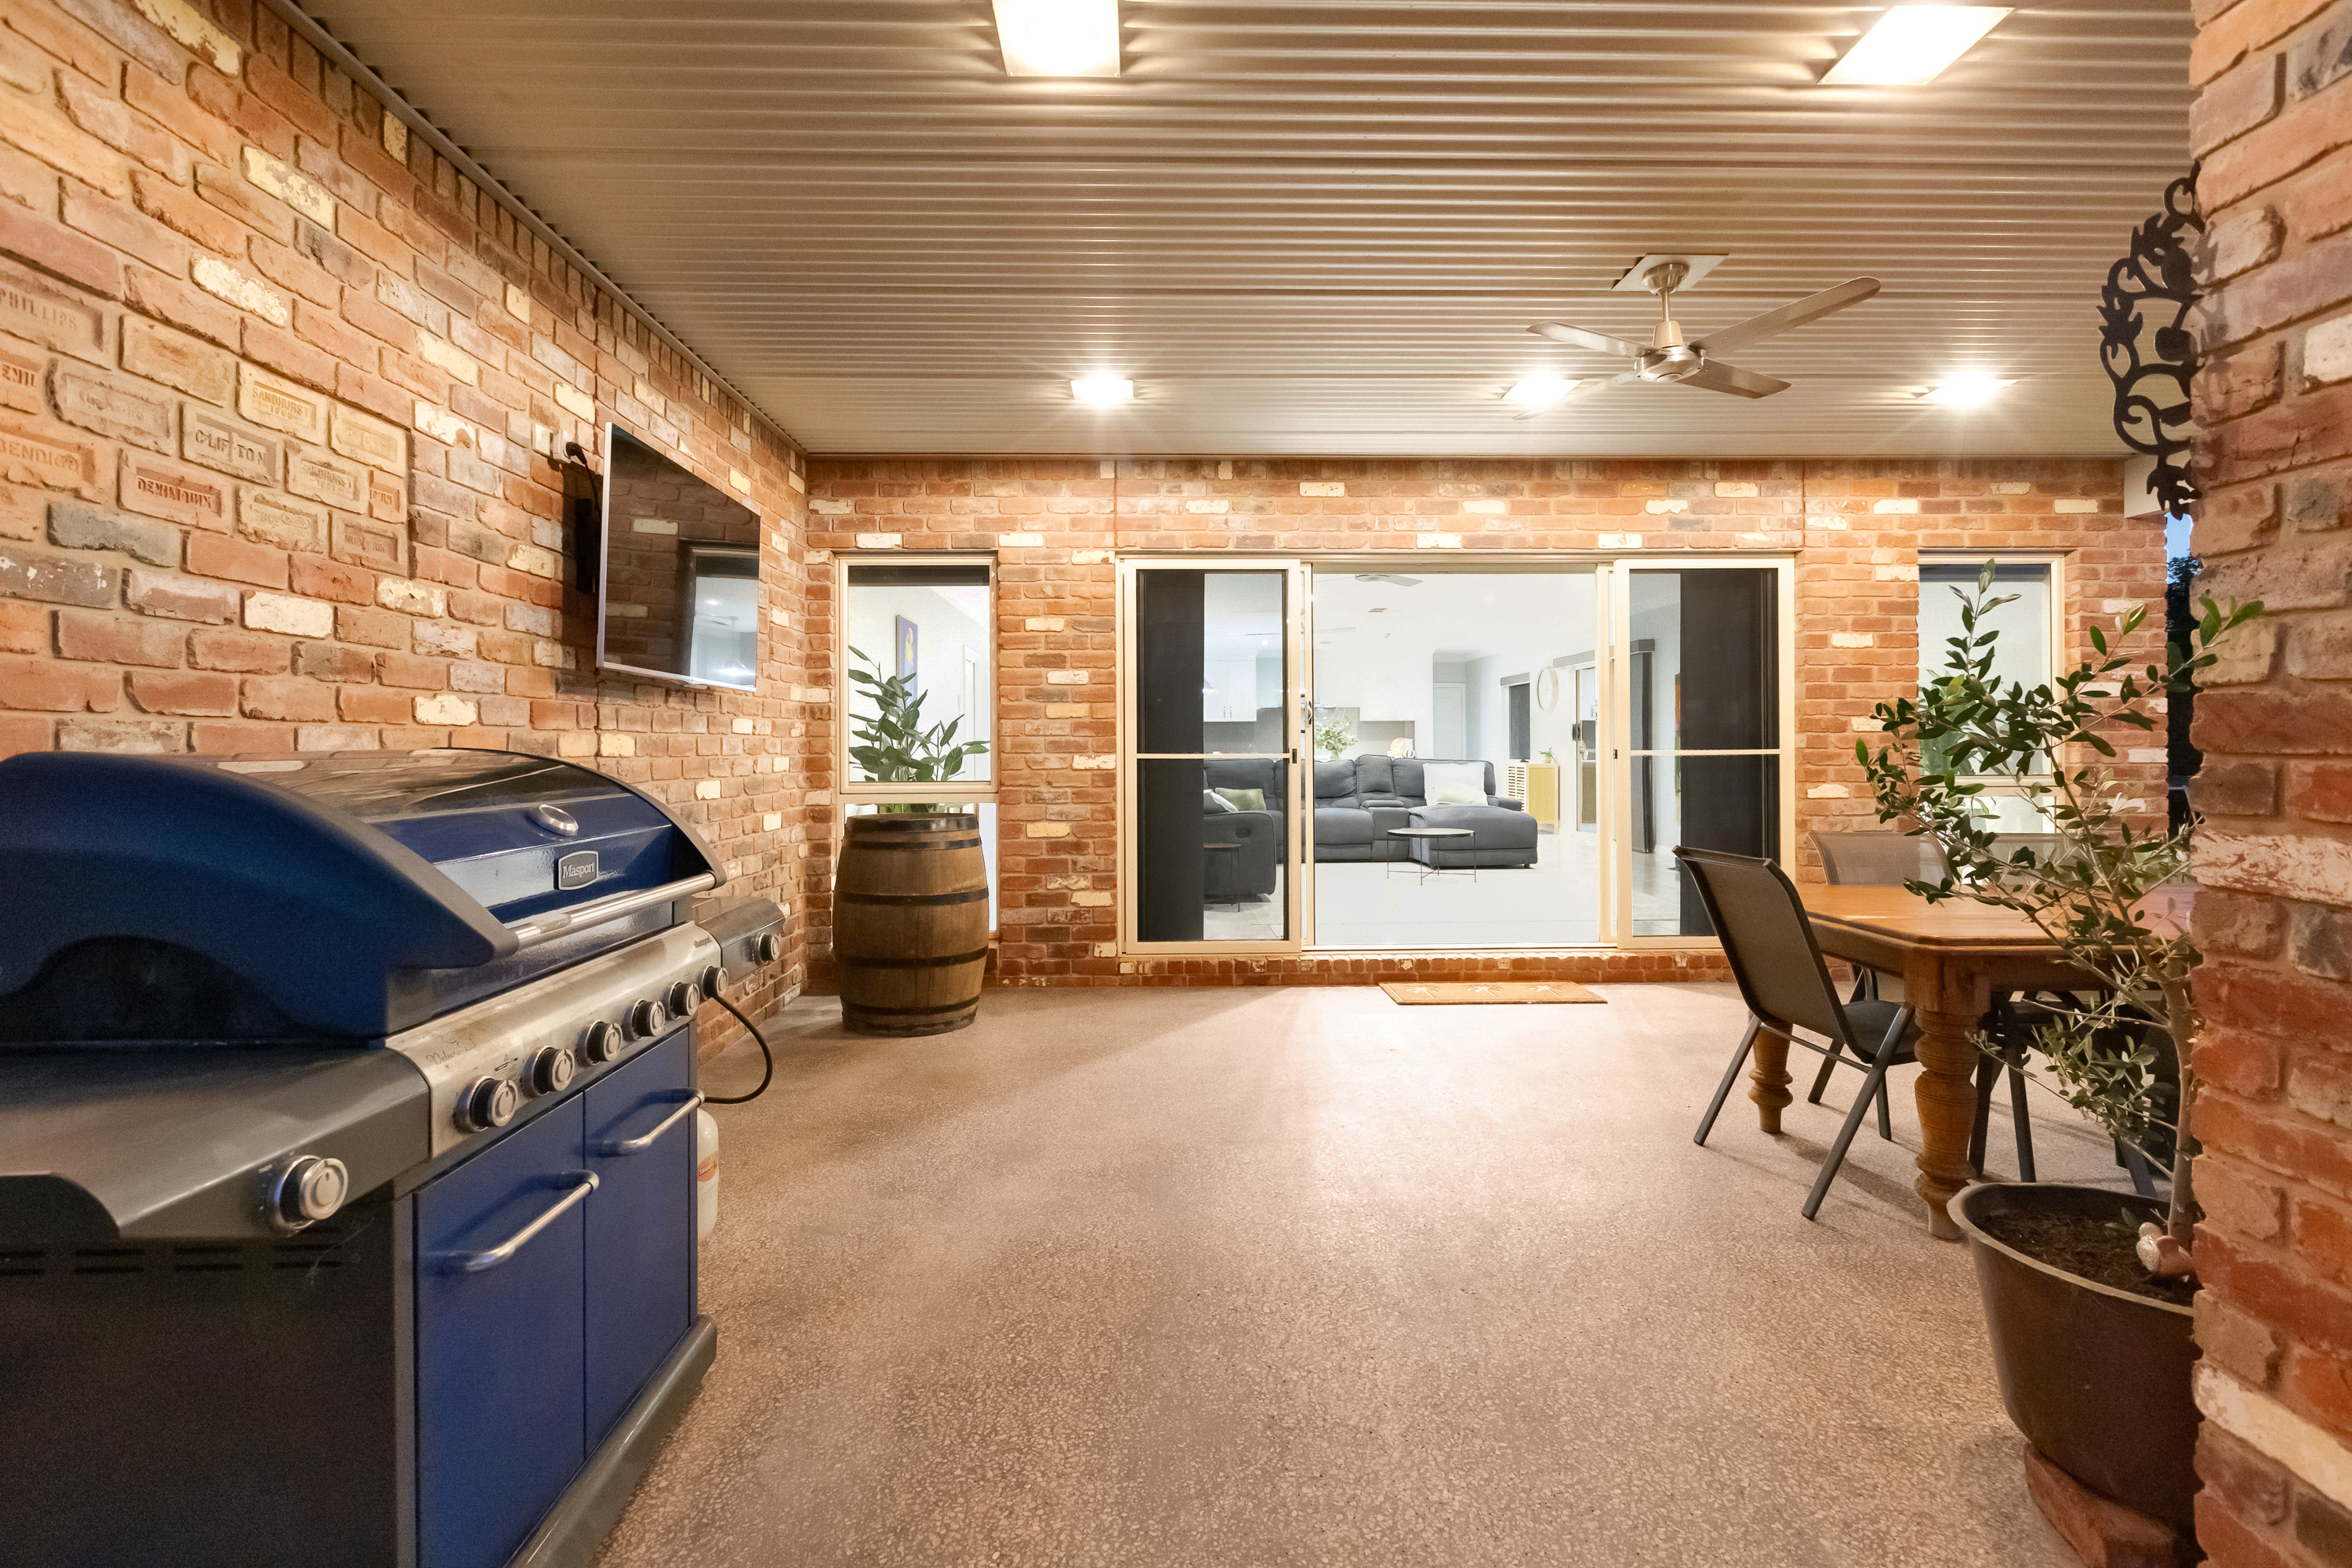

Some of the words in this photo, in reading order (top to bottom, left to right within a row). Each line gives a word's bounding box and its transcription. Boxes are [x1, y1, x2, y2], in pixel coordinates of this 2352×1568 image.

[252, 387, 310, 417] SANDHURST
[195, 429, 263, 465] CLIFTON
[302, 463, 352, 490] SANDHURST
[562, 861, 595, 879] Masport
[426, 1050, 461, 1065] Delue
